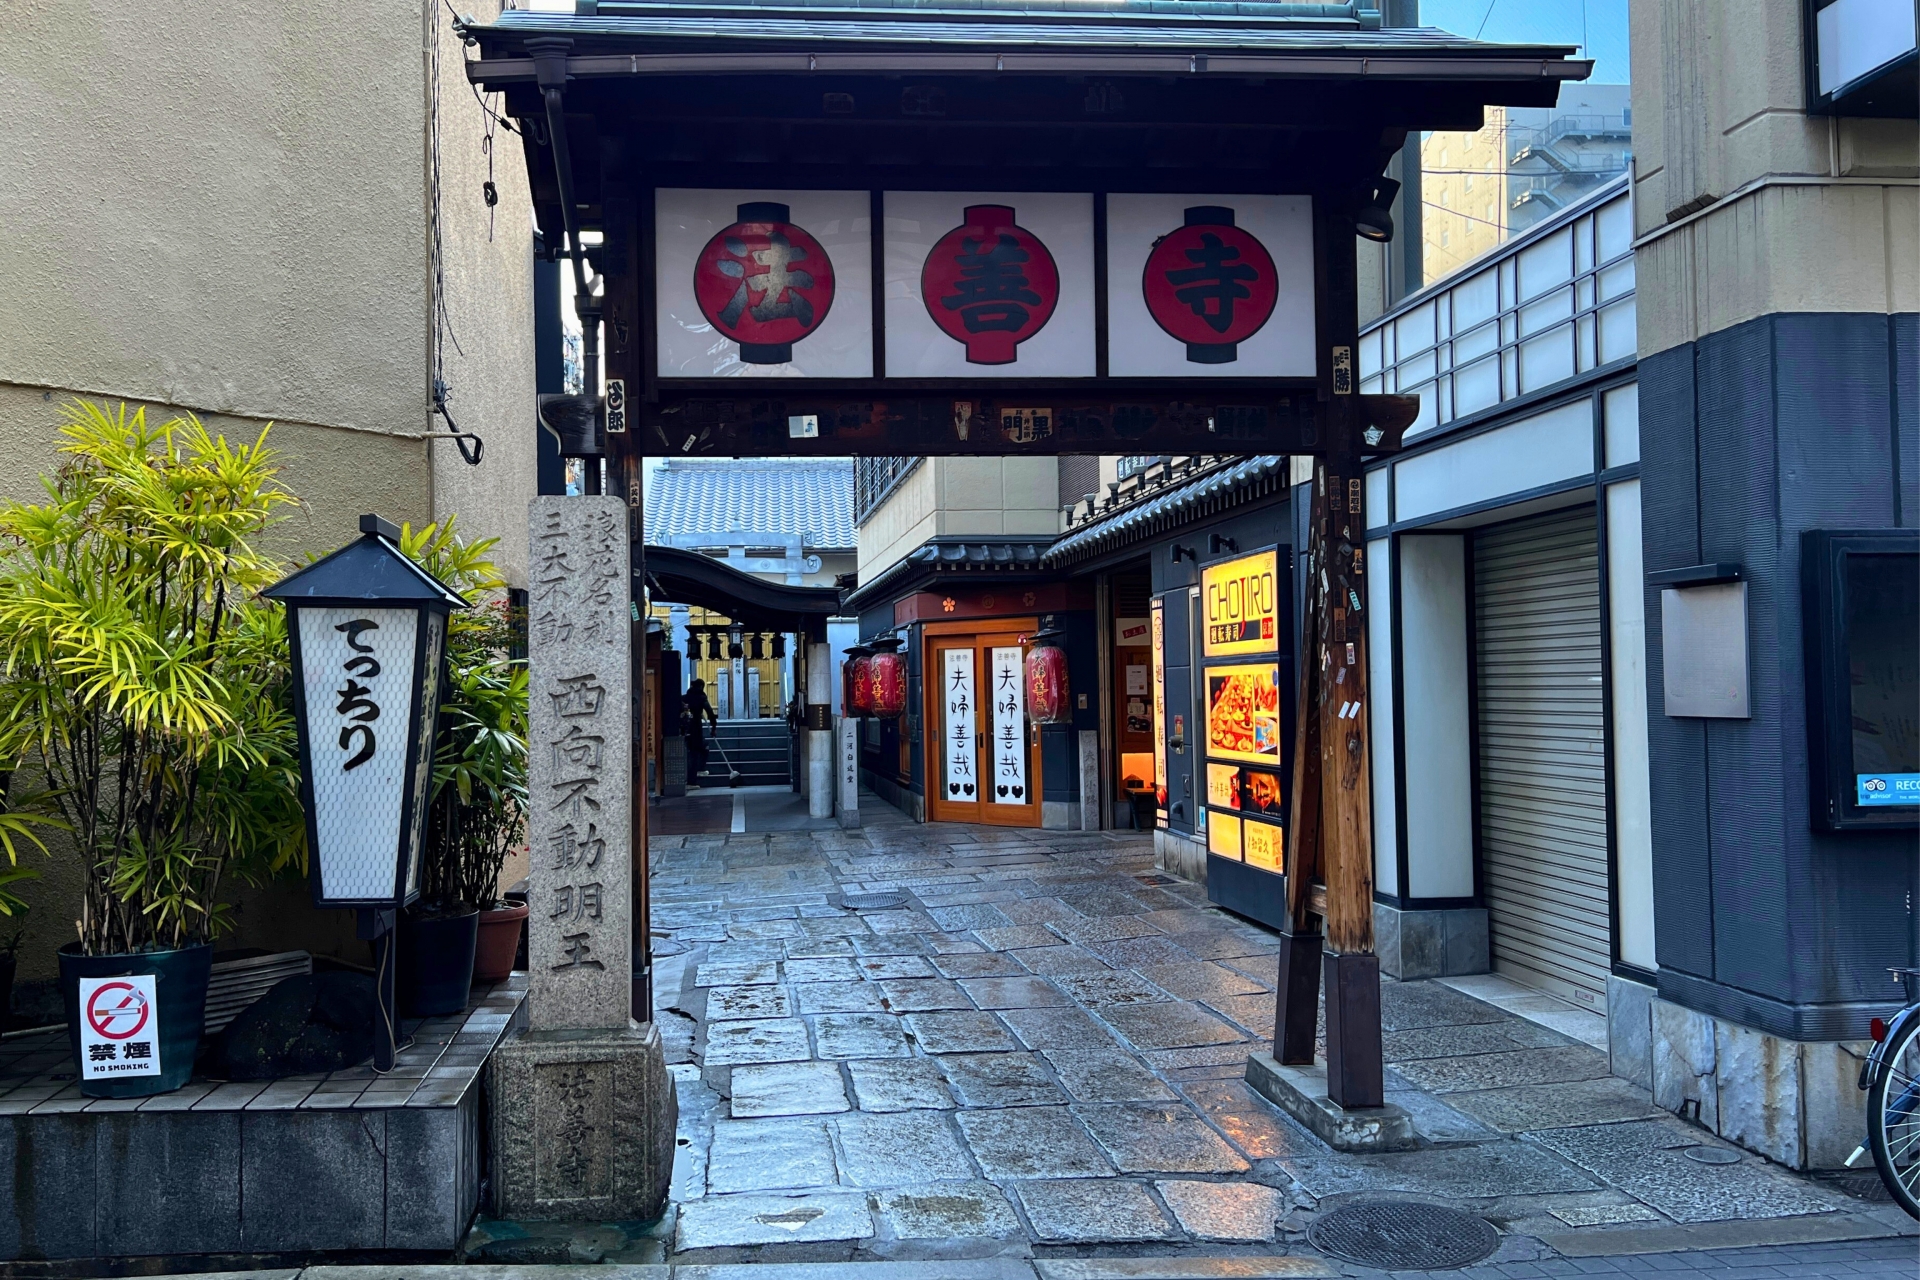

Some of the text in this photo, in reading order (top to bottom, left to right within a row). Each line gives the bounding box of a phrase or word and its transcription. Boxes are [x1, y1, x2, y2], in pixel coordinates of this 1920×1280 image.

[536, 511, 576, 647] 三大不動
[1208, 572, 1273, 637] CHOJIRO
[334, 618, 381, 771] てっちり
[950, 663, 972, 777] 夫婦善哉
[998, 664, 1021, 779] 夫婦善哉
[549, 672, 607, 972] 西向不動明王
[88, 1041, 152, 1061] 禁煙
[108, 1063, 149, 1071] SMOKING
[552, 1068, 595, 1185] 法善寺
